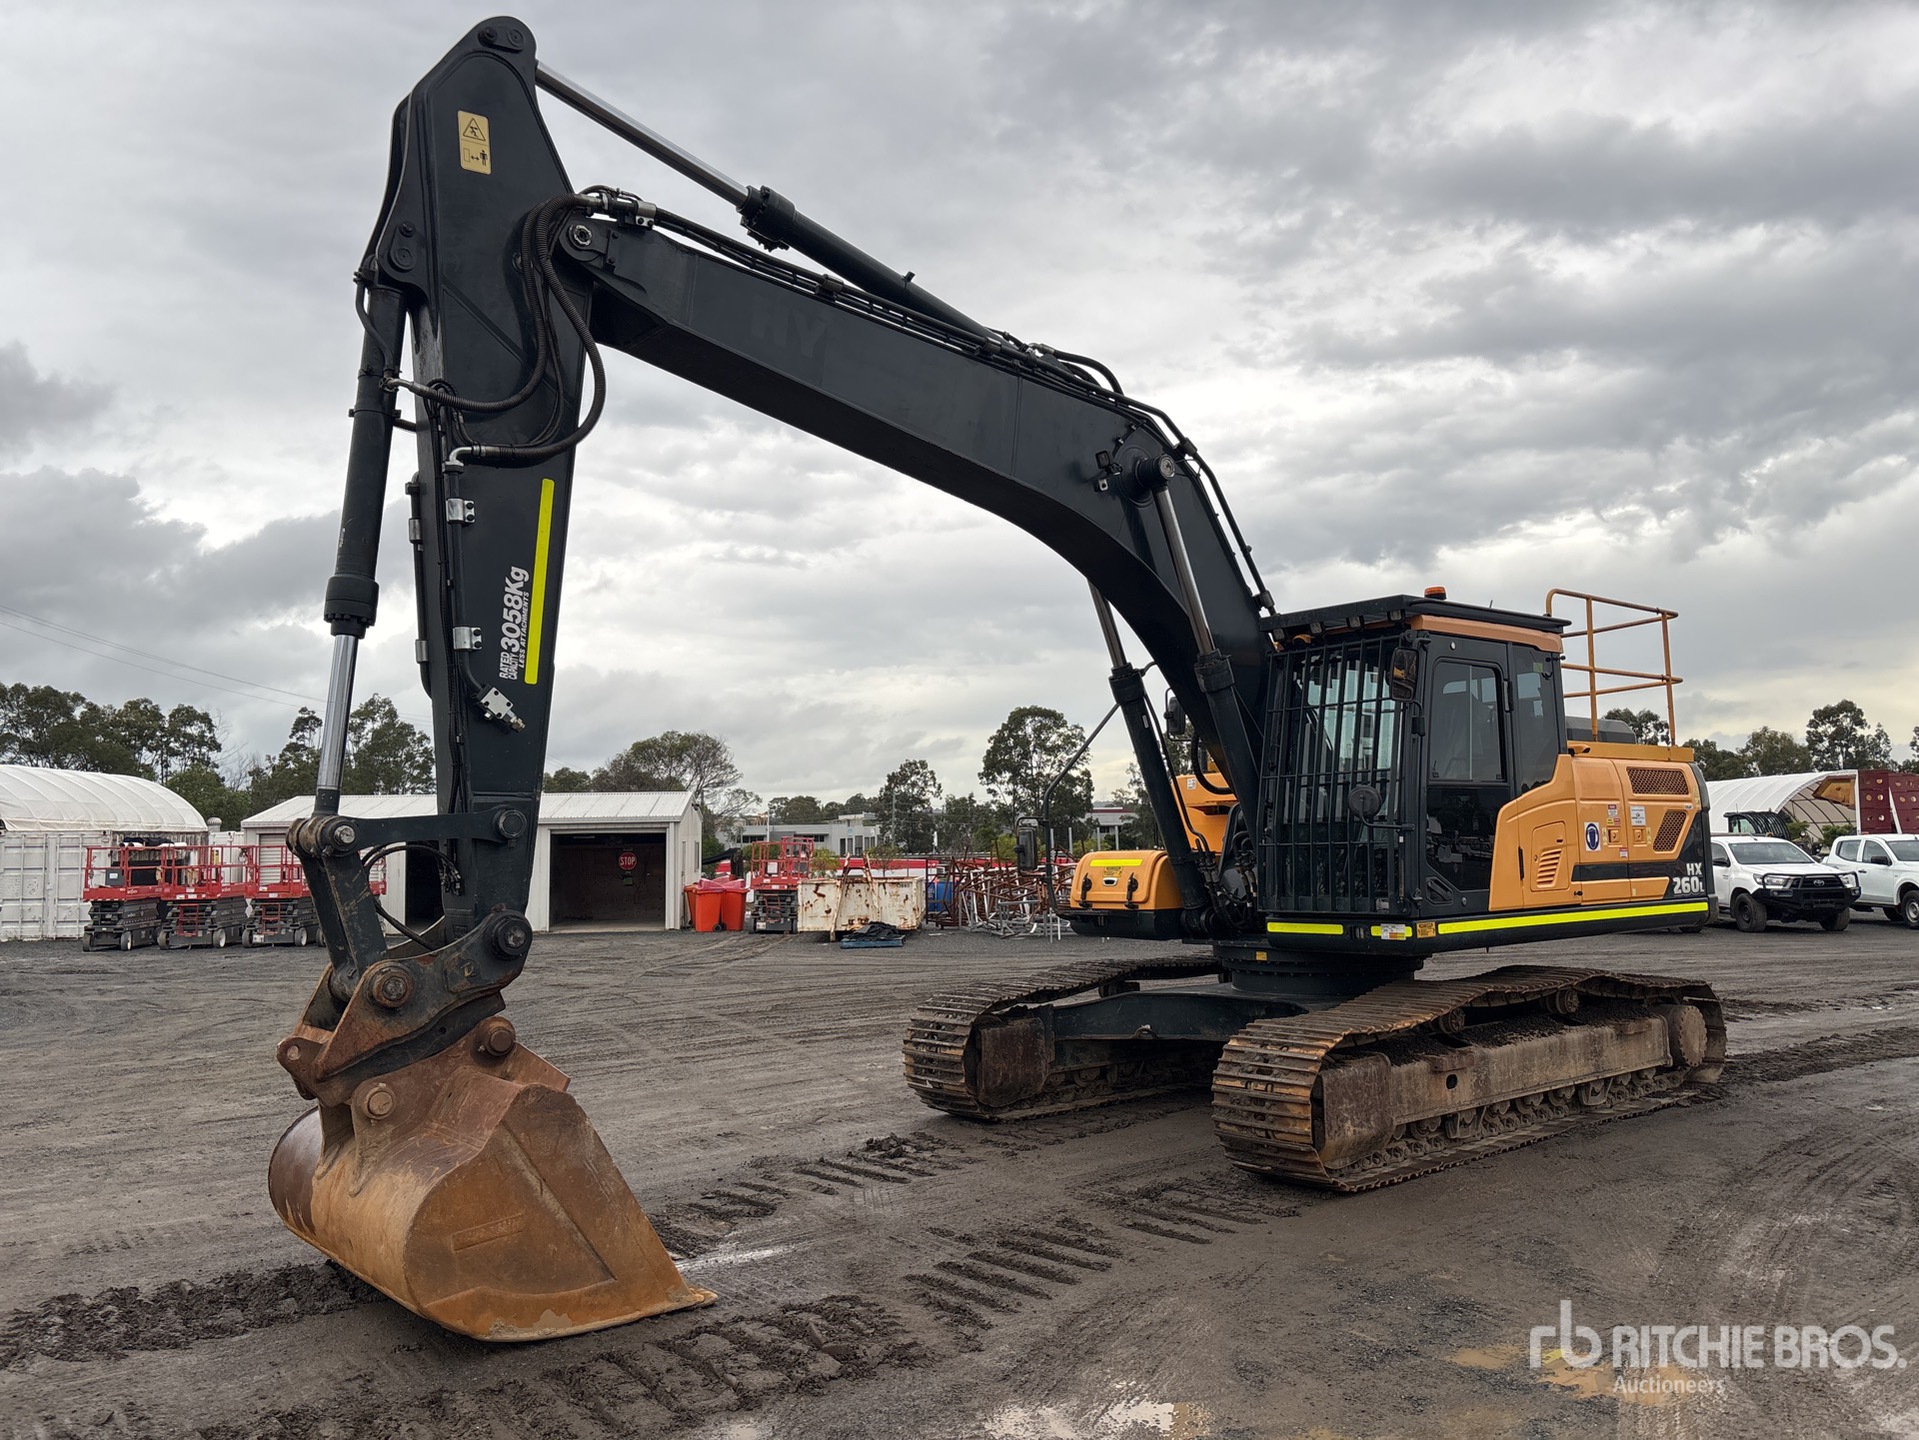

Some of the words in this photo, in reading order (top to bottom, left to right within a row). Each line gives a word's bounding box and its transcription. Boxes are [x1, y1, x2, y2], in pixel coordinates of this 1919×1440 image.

[500, 566, 529, 652] 3058Kg
[520, 591, 529, 647] ATTACHMENTS
[499, 651, 509, 679] RATED
[508, 653, 518, 680] CAPACITY
[620, 856, 636, 866] STOP
[1686, 863, 1702, 876] HX
[1673, 876, 1705, 895] 260L
